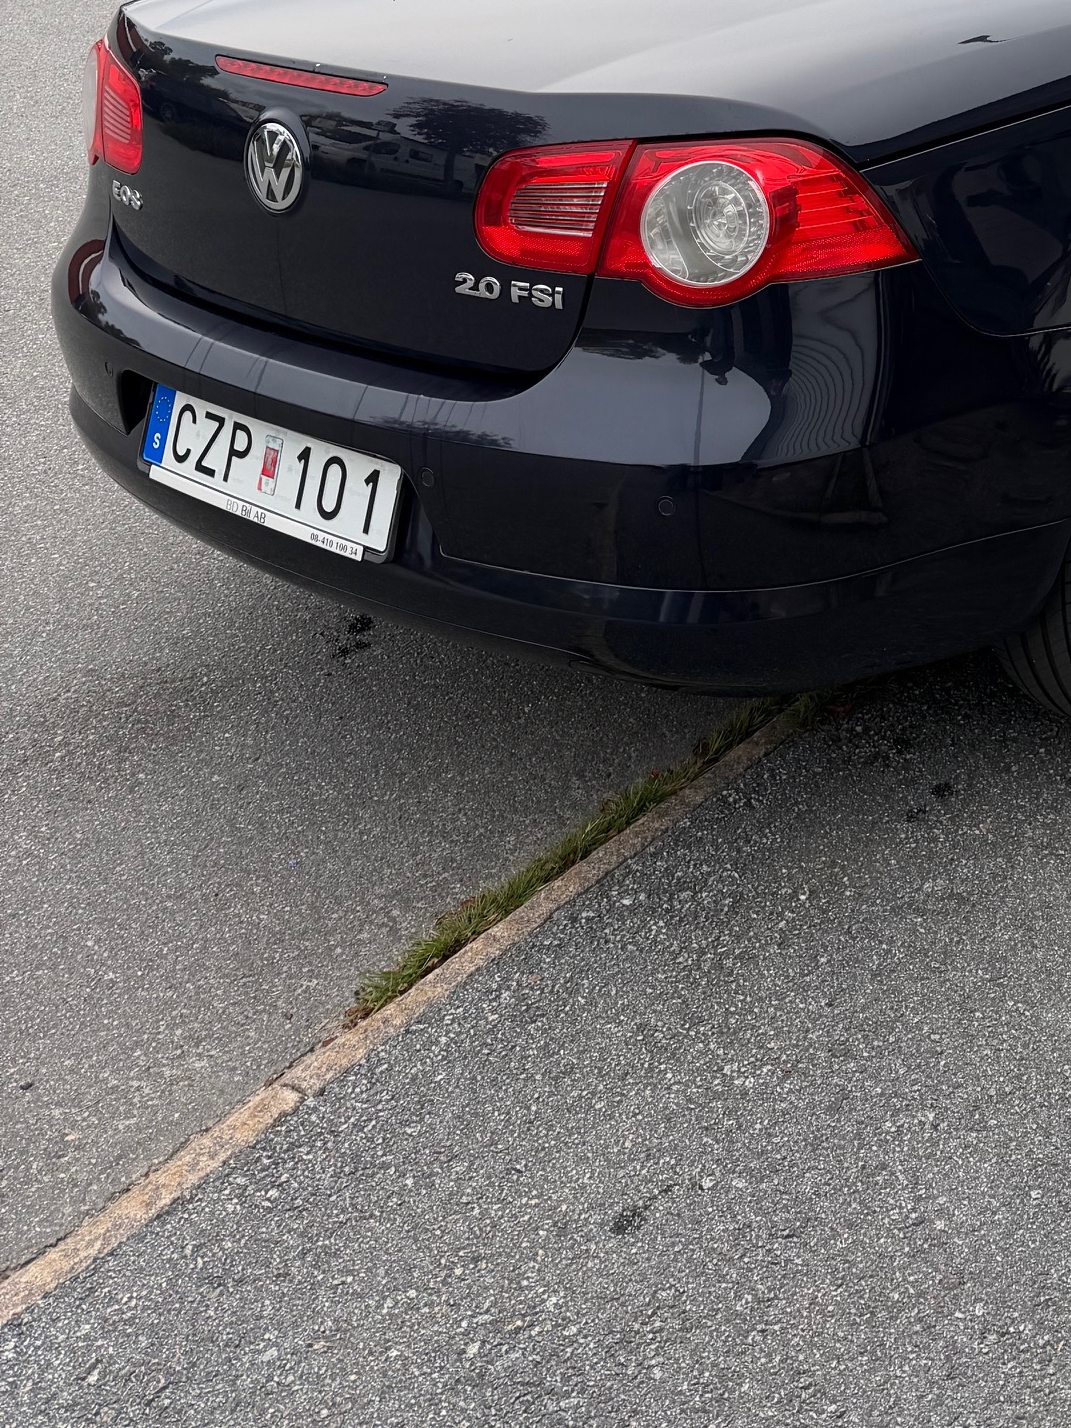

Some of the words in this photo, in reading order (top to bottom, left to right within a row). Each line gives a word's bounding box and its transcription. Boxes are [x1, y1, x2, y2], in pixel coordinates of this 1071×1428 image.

[152, 432, 162, 449] S
[172, 403, 252, 483] CZP
[295, 445, 381, 535] 101
[225, 498, 239, 513] BD
[240, 503, 253, 519] Bil
[252, 510, 266, 524] AB
[310, 532, 334, 549] 08-410
[335, 541, 348, 554] 100
[349, 546, 358, 557] 34
